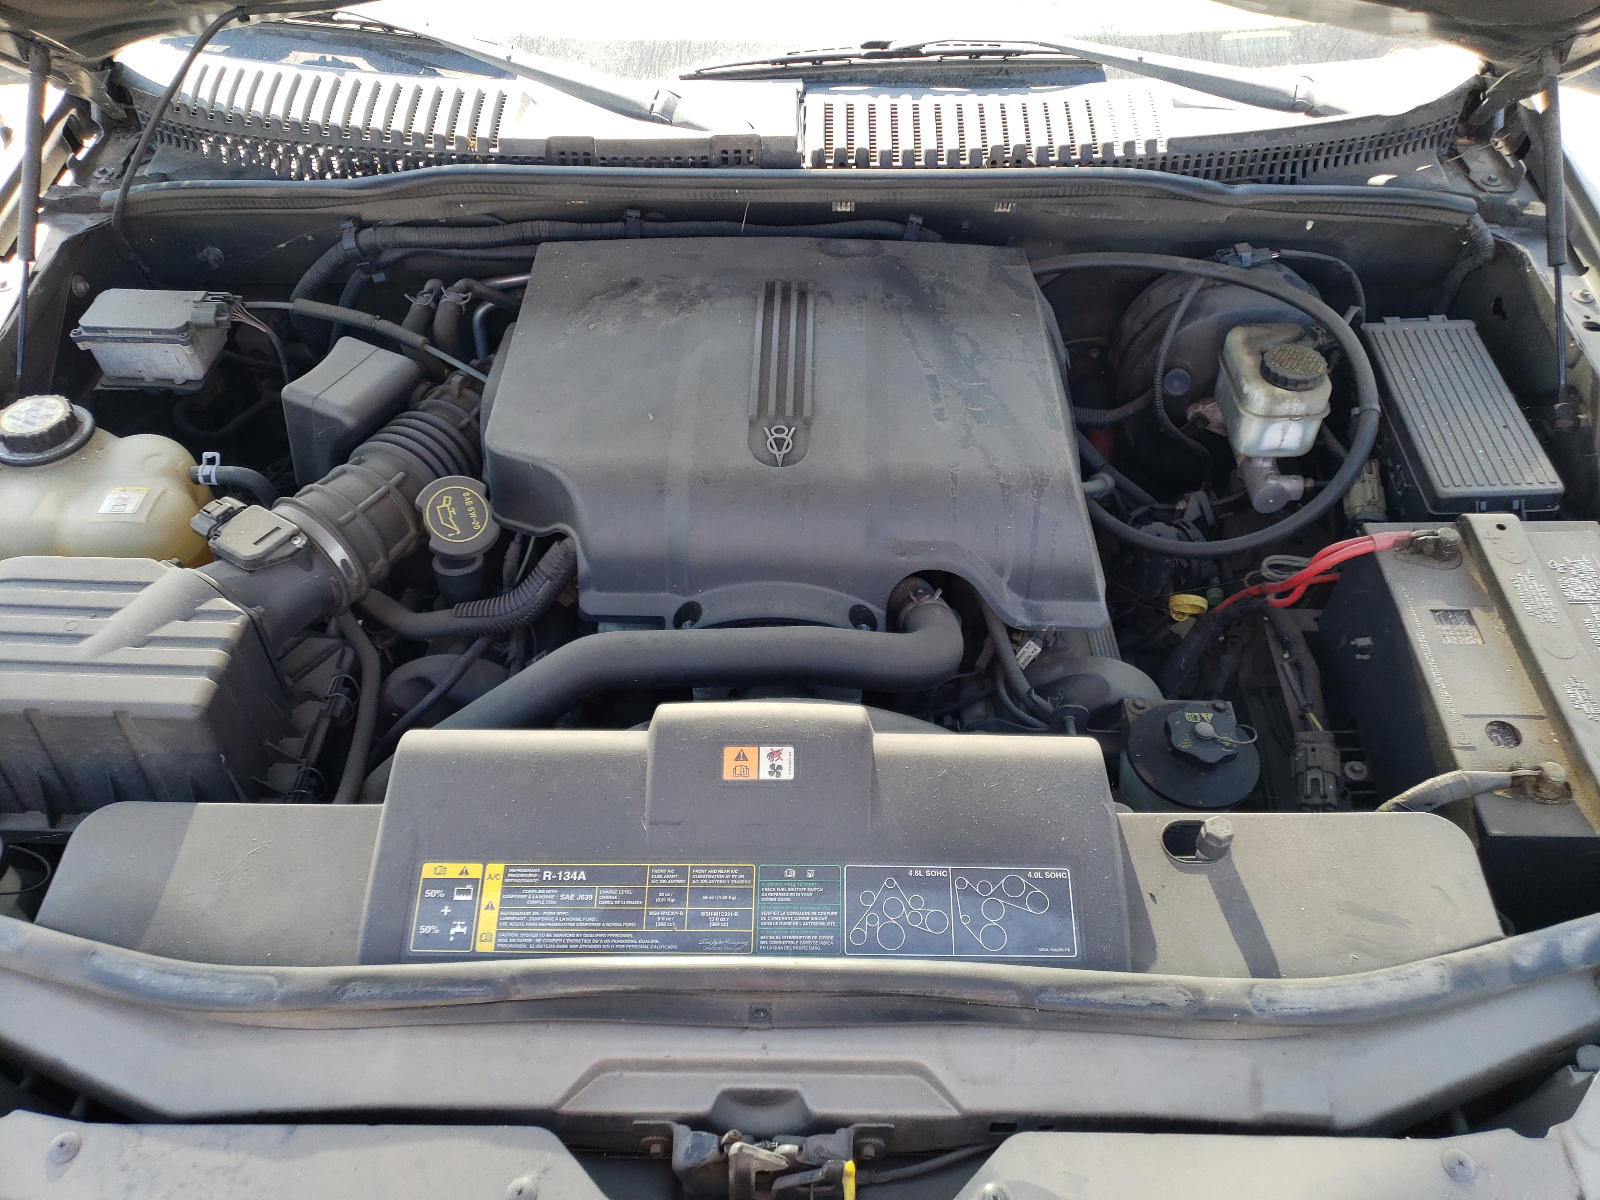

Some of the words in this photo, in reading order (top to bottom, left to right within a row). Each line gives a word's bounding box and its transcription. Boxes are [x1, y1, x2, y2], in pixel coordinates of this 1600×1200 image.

[462, 491, 473, 506] SAE
[487, 873, 502, 881] A/C
[542, 870, 587, 881] R-134A
[424, 889, 445, 898] 50%
[419, 925, 440, 934] 50%
